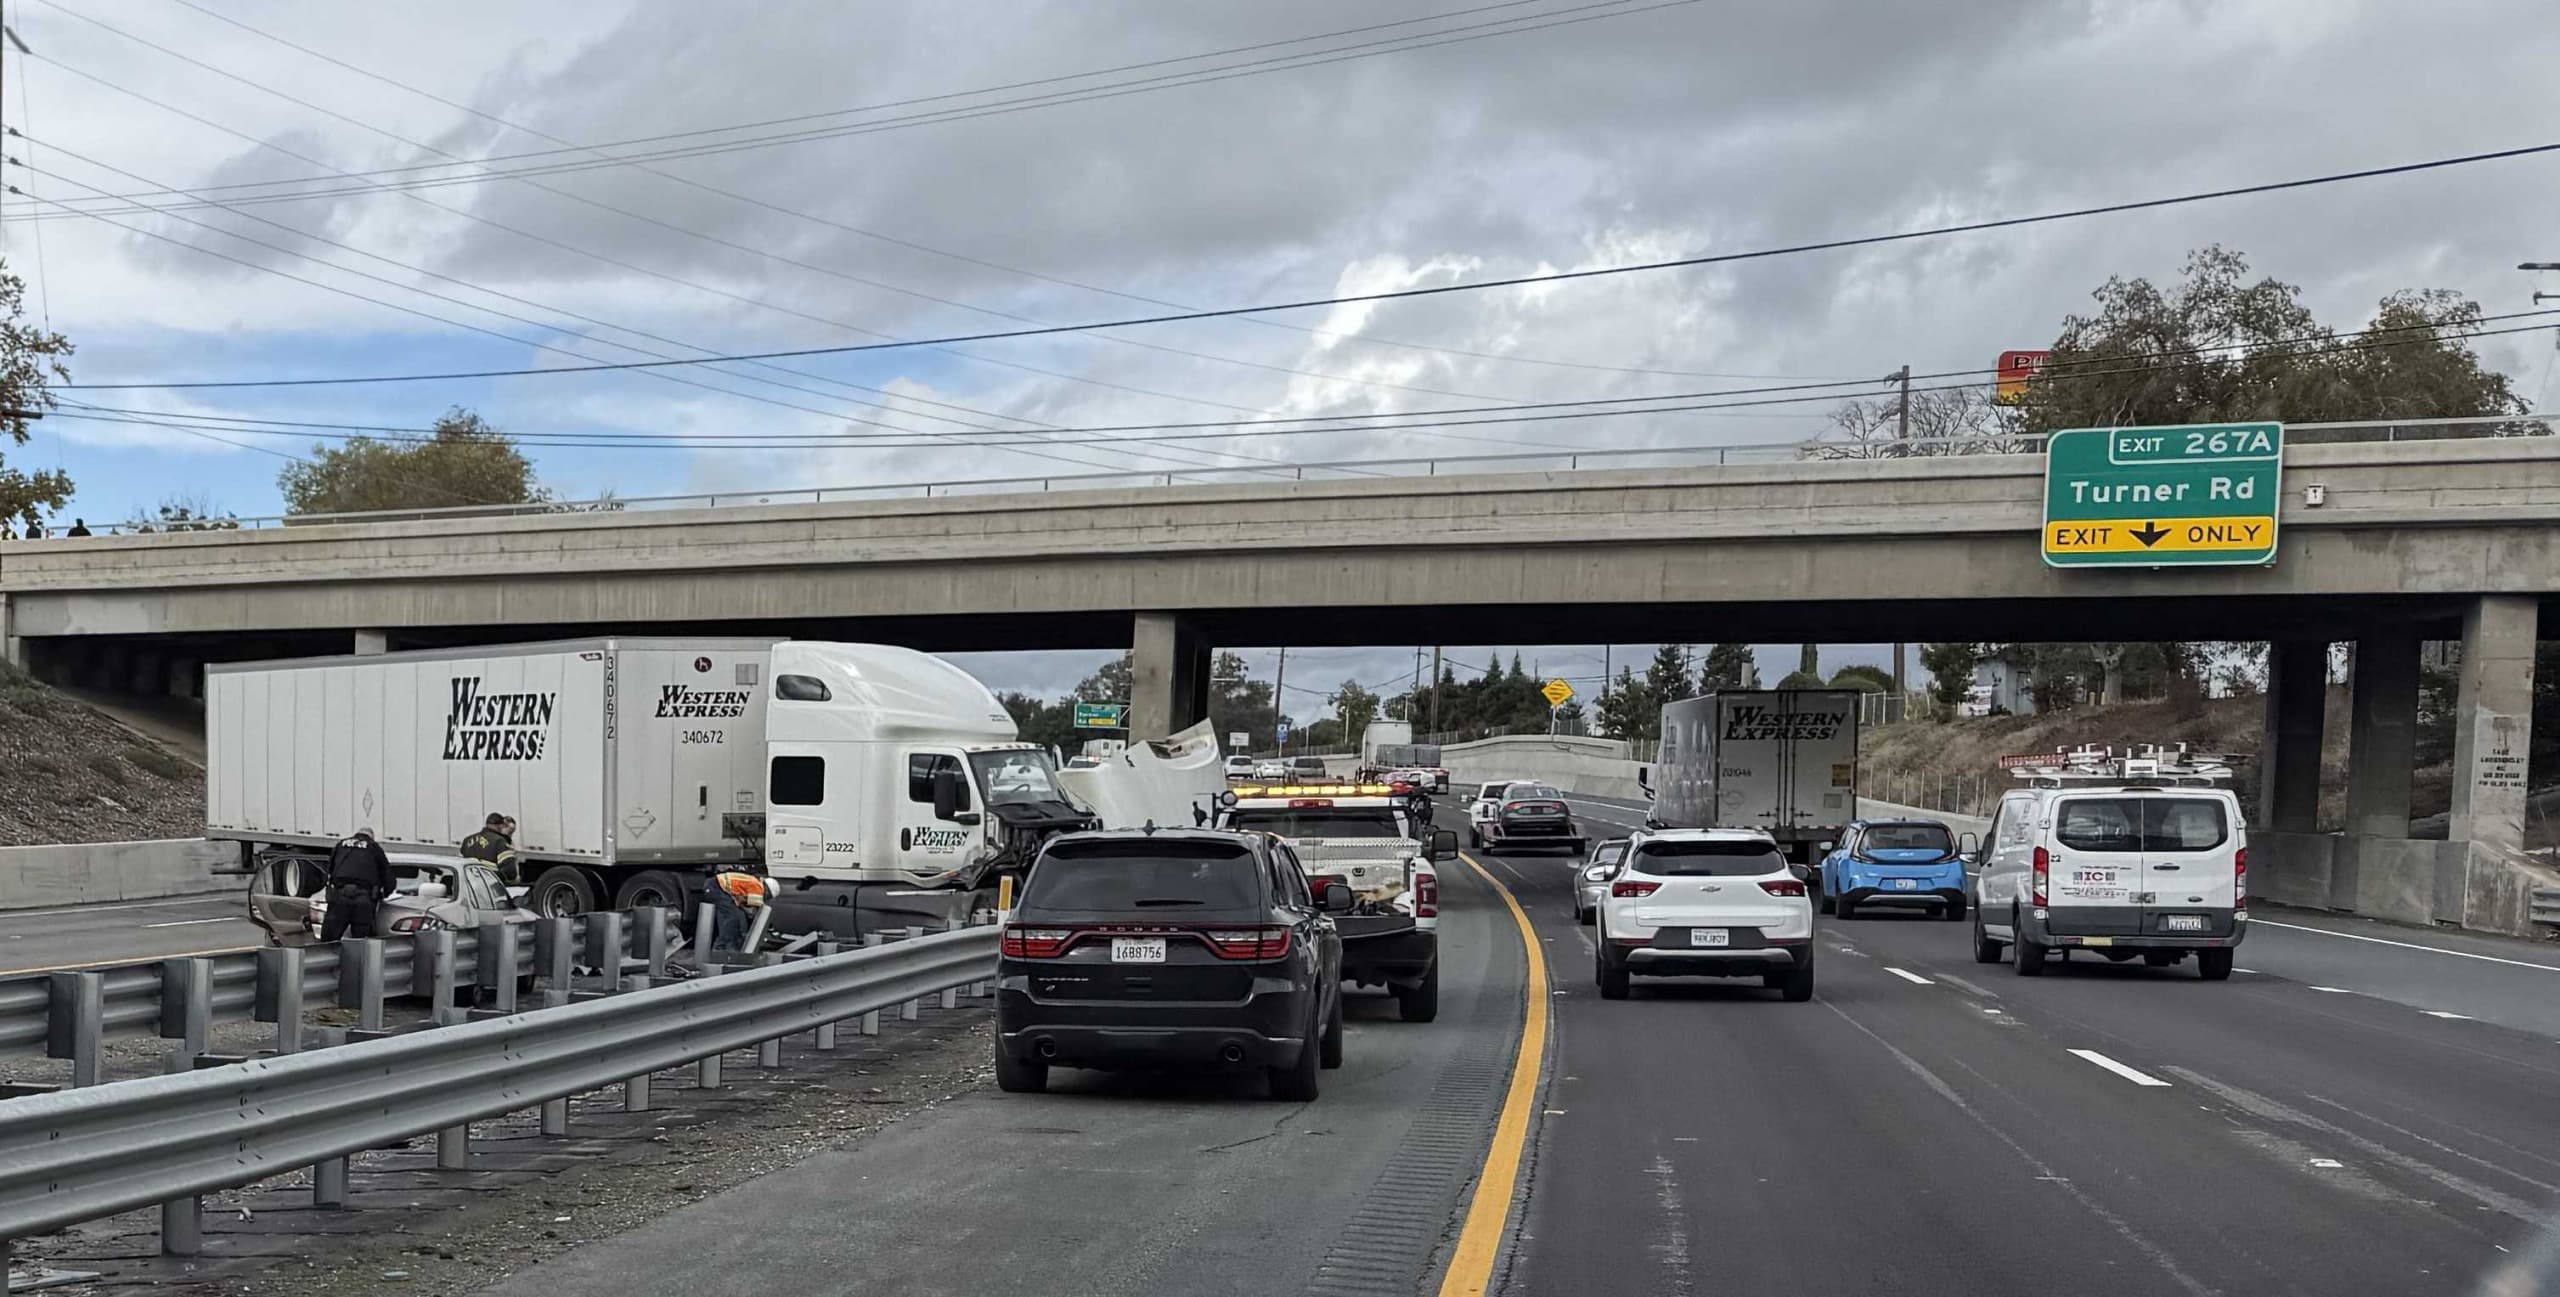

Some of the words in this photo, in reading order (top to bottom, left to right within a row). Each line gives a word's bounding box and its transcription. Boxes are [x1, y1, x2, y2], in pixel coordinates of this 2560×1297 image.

[2119, 437, 2164, 453] EXIT
[2184, 431, 2272, 454] 267A
[2070, 480, 2190, 503] Turner
[2210, 476, 2255, 500] Rd
[2056, 528, 2112, 545] EXIT
[2188, 524, 2262, 543] ONLY
[451, 677, 556, 727] WESTERN
[606, 656, 615, 739] 340672
[662, 684, 751, 705] WESTERN
[655, 699, 741, 718] EXPRESS
[1732, 706, 1848, 727] WESTERN
[442, 714, 540, 760] EXPRESS
[681, 730, 724, 744] 340672
[1723, 721, 1832, 740] EXPRESS
